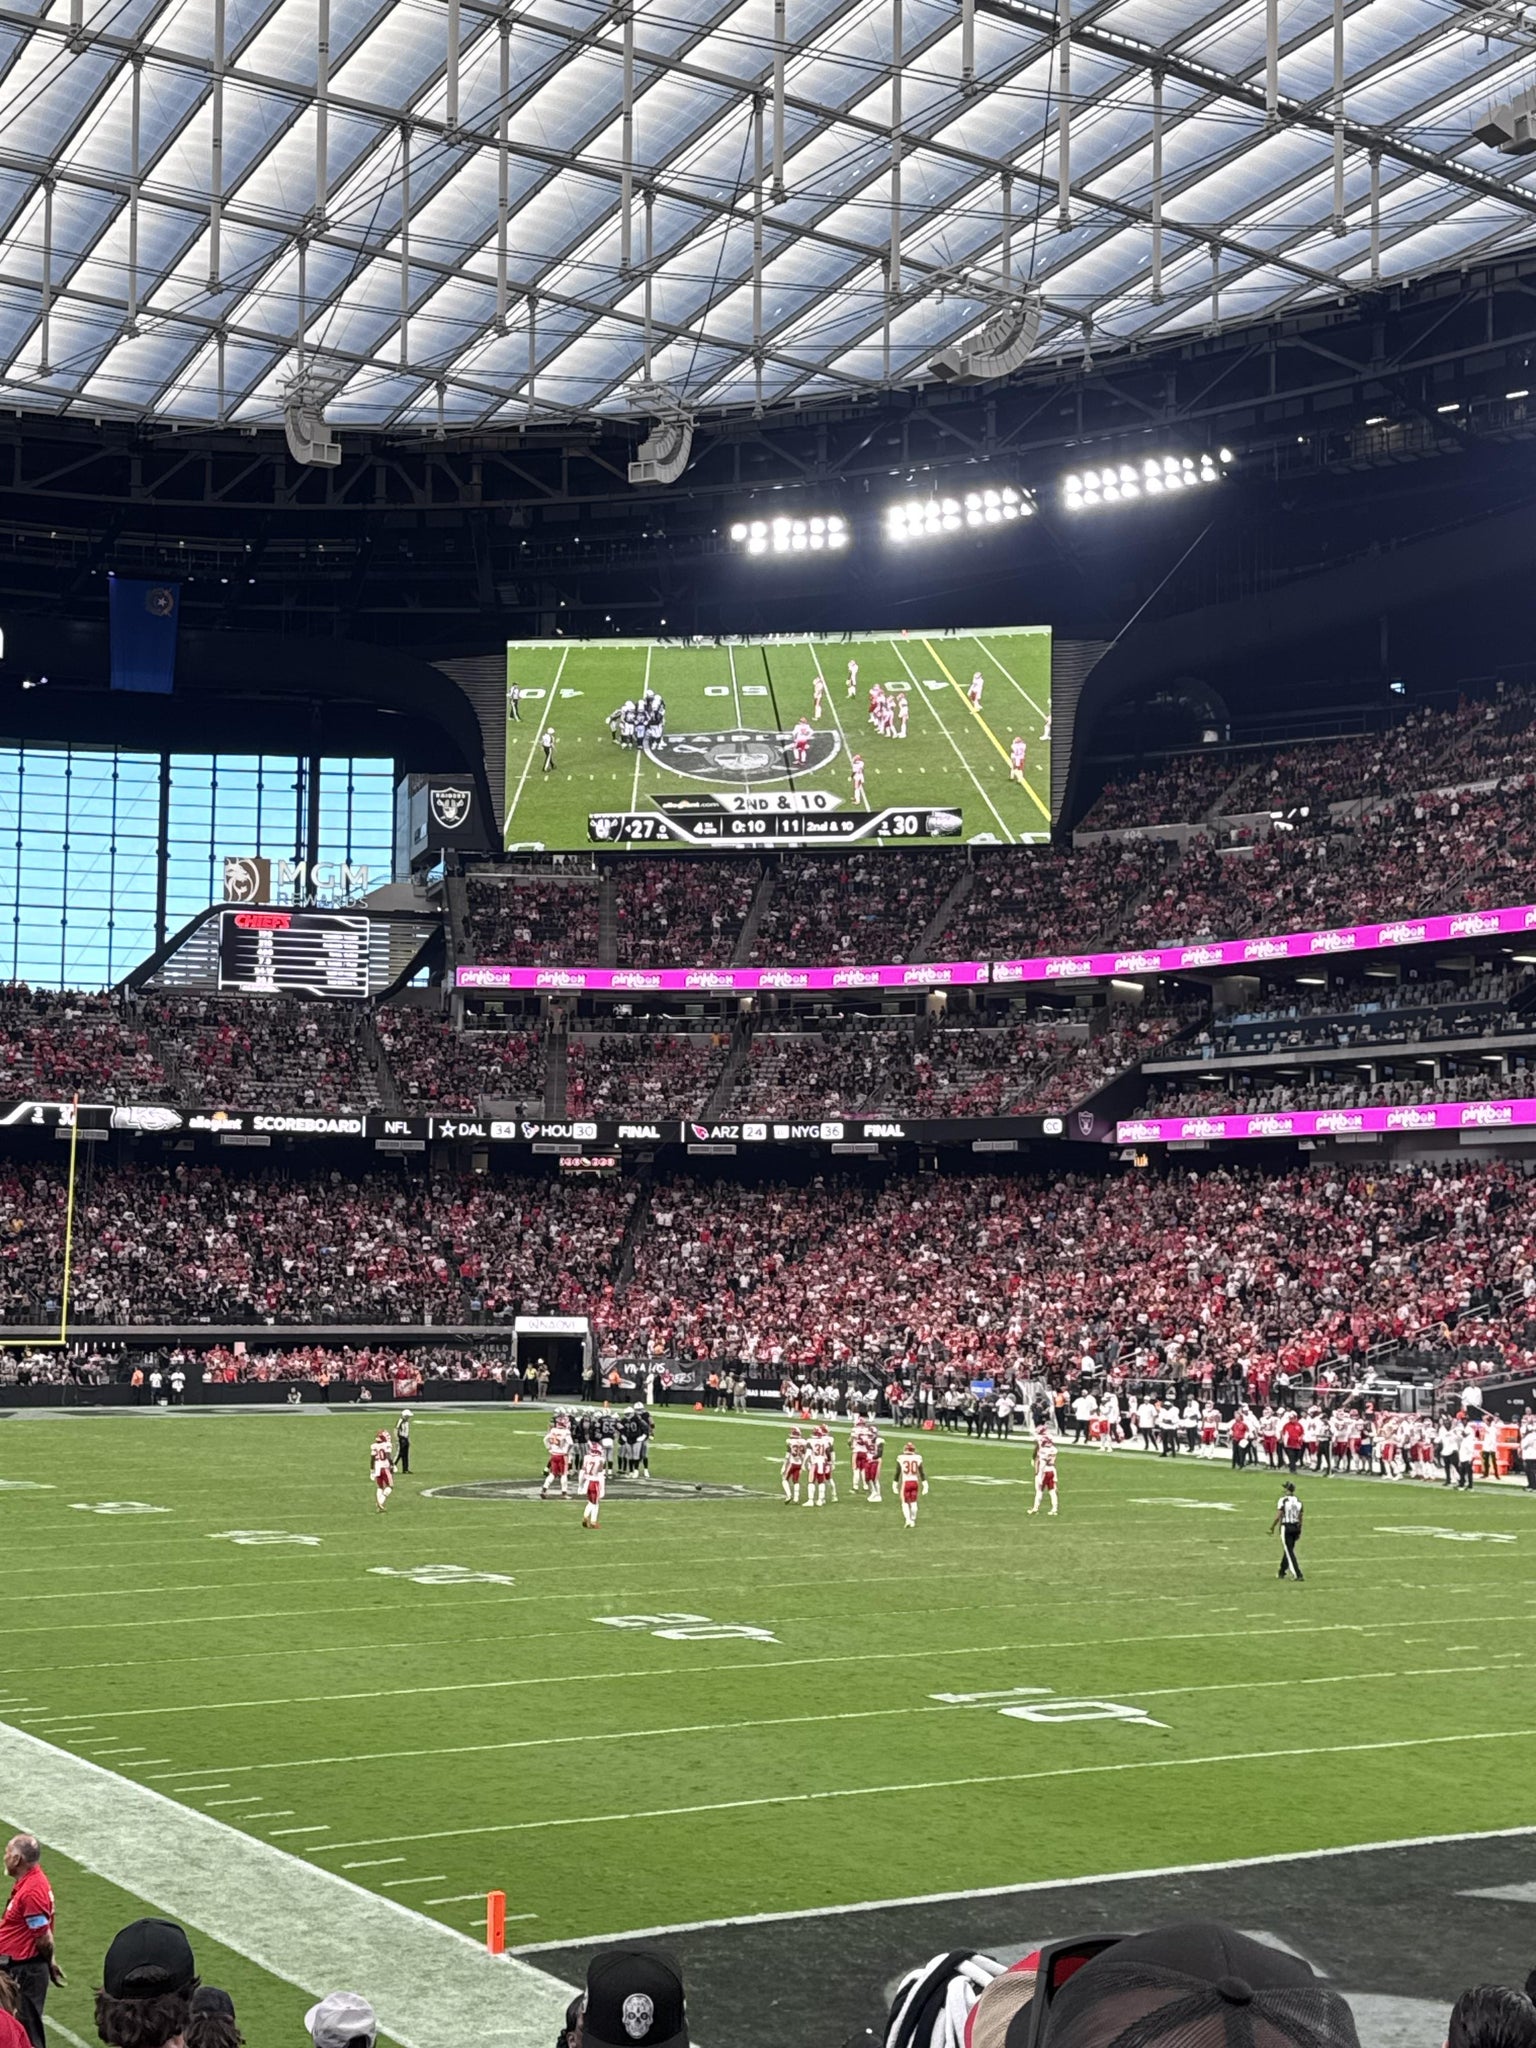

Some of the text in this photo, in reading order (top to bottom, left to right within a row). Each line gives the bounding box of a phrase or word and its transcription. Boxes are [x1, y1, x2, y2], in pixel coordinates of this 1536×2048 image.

[734, 794, 826, 811] 2ND & 10
[631, 819, 654, 838] 27
[732, 820, 766, 833] 0:10
[782, 819, 799, 832] 11
[806, 821, 828, 832] 2nd
[841, 820, 854, 831] 10
[893, 815, 918, 835] 30
[278, 859, 368, 891] MGM
[277, 891, 369, 909] REWARDS
[234, 914, 292, 929] CHIEFS
[461, 970, 511, 986] pinkbox
[536, 971, 586, 986] pinkbox
[611, 972, 660, 987] pinkbox
[685, 972, 734, 987] pinkbox
[759, 971, 808, 986] pinkbox
[833, 969, 879, 985] pinkbox
[904, 967, 951, 983] pinkbox
[1046, 959, 1090, 976] pinkbox
[1114, 953, 1160, 970] pinkbox
[1181, 947, 1223, 965] pinkbox
[1244, 941, 1288, 959] pinkbox
[1311, 933, 1355, 951] pinkbox
[1379, 924, 1426, 943] pinkbox
[1450, 915, 1499, 936] pinkbox
[253, 1115, 361, 1133] SCOREBOARD
[385, 1121, 411, 1134] NFL
[1046, 1122, 1059, 1132] CC
[1119, 1105, 1512, 1140] pinkbox pinkbox pinkbox pinkbox pinkbox pinkbox
[458, 1123, 511, 1137] DAL 34
[542, 1124, 594, 1137] HOU 30
[618, 1125, 660, 1139] FINAL
[711, 1126, 739, 1139] ARZ
[747, 1127, 763, 1137] 24
[791, 1125, 819, 1138] NYG
[825, 1126, 840, 1137] 36
[863, 1124, 905, 1138] FINAL
[602, 1421, 615, 1434] 65
[815, 1443, 825, 1457] 31
[903, 1460, 918, 1475] 30
